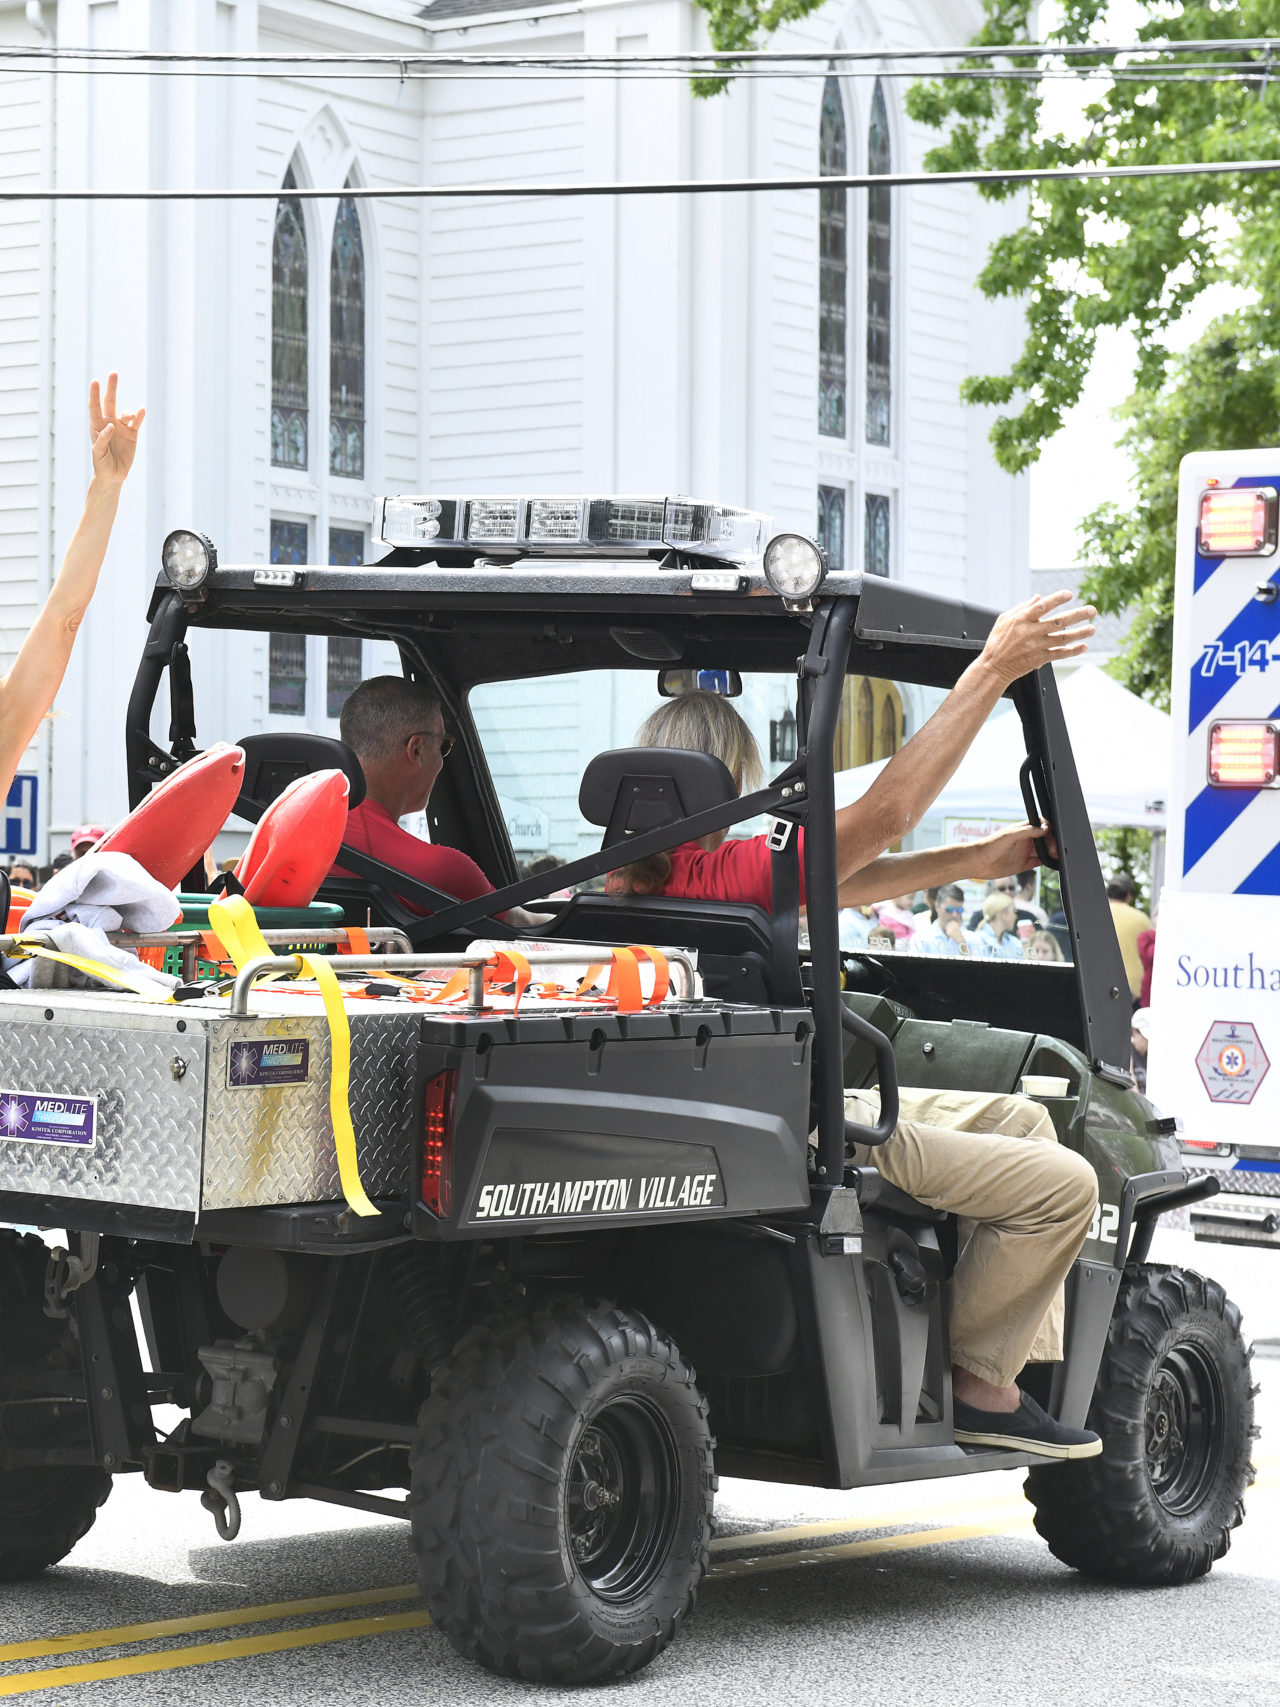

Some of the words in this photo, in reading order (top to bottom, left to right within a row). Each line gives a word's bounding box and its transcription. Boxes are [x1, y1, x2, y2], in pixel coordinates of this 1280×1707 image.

[508, 814, 542, 837] Church
[1176, 952, 1280, 992] Southa
[262, 1042, 305, 1055] MEDLITE
[35, 1100, 89, 1114] MEDLITE
[52, 1128, 88, 1136] CORPORATION
[476, 1178, 632, 1218] SOUTHAMPTON
[638, 1174, 717, 1209] VILLAGE
